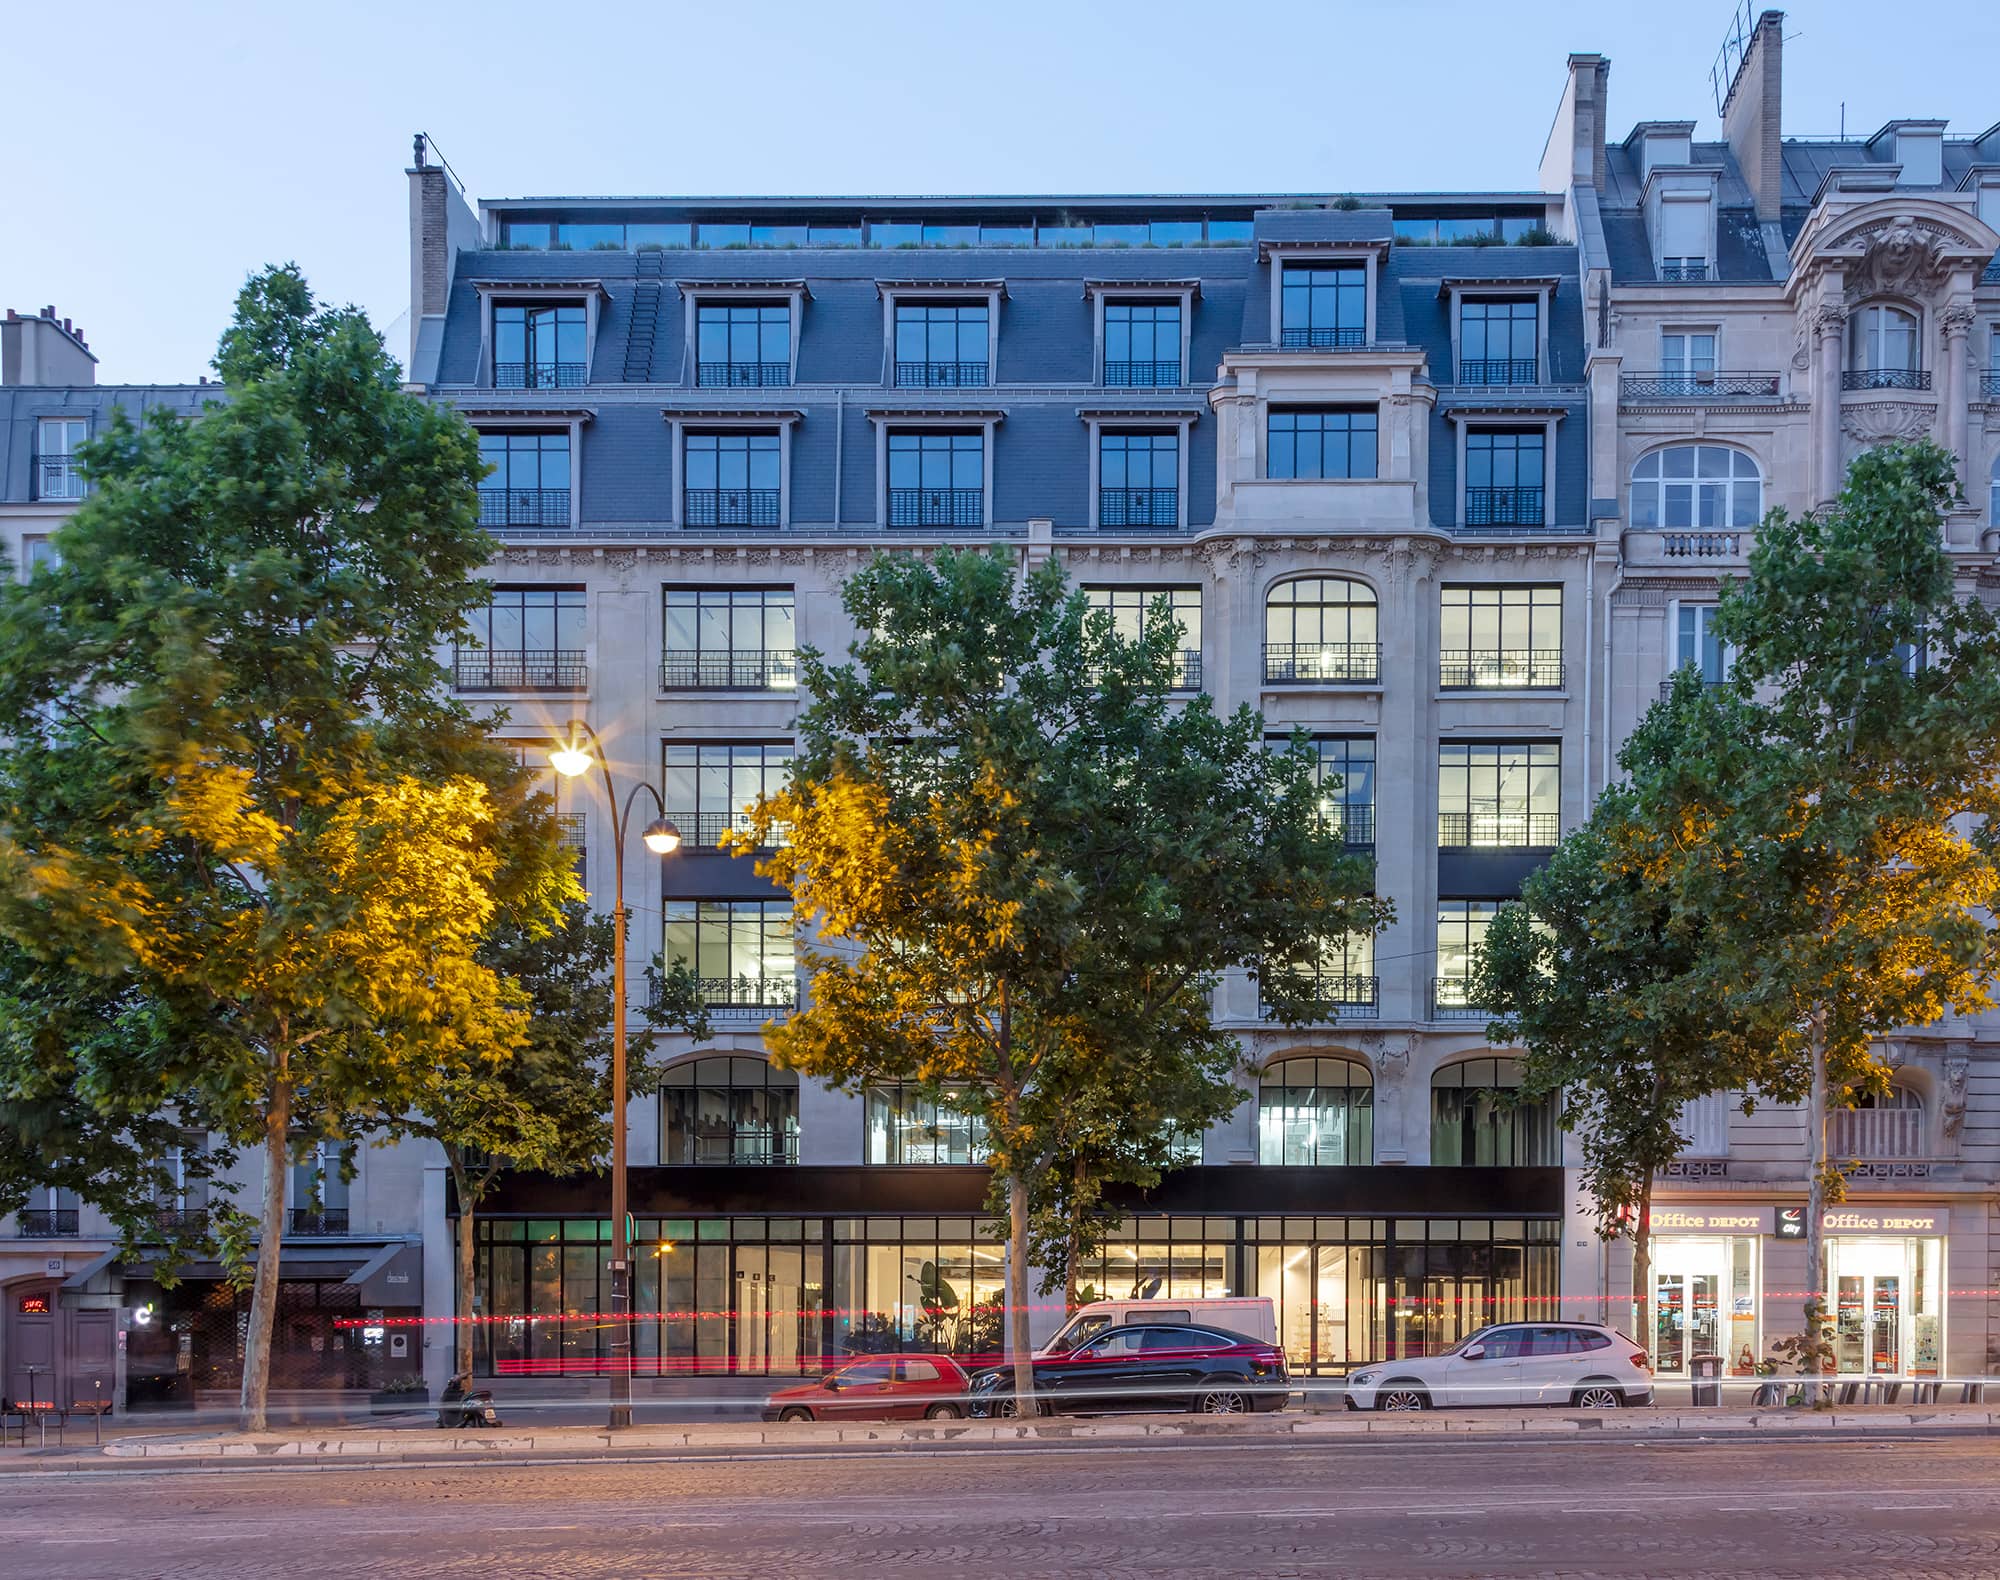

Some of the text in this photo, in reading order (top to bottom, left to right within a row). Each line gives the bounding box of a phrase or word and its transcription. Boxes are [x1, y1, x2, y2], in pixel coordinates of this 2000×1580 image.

[1649, 1213, 1760, 1227] Office DEPOT
[1823, 1215, 1934, 1229] Office DEPOT
